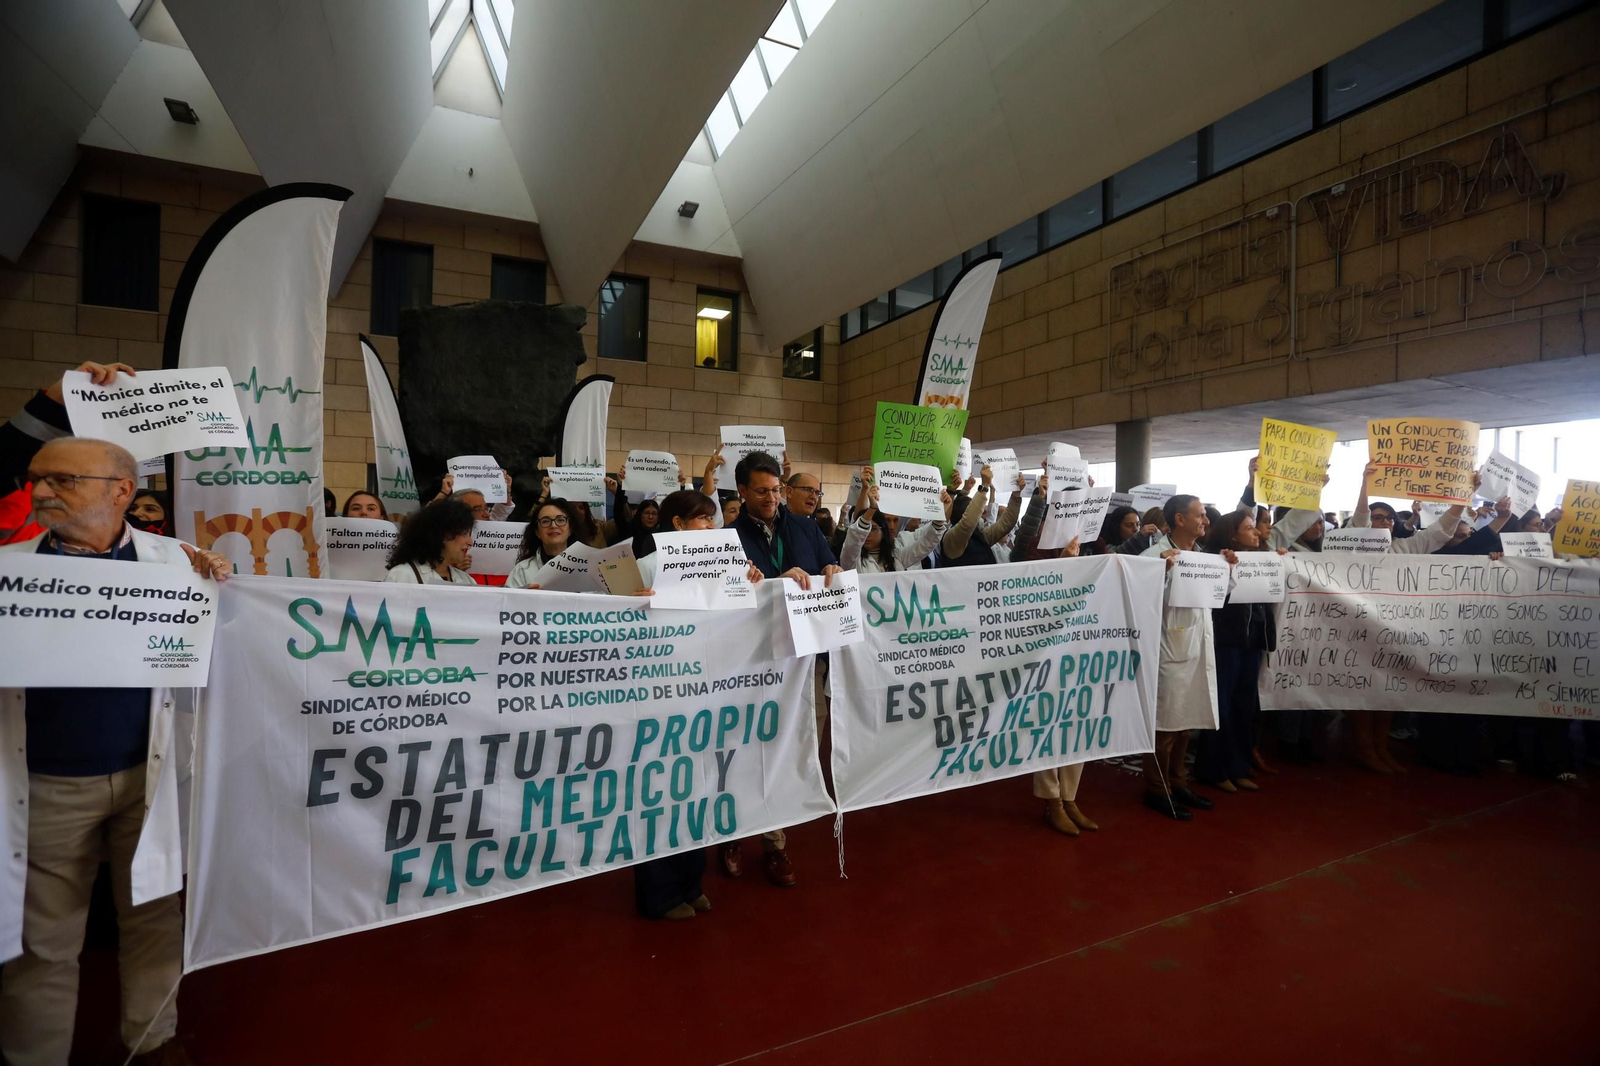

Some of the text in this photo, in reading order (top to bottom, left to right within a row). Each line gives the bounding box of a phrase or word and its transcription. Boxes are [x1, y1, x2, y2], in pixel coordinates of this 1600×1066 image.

[1111, 221, 1288, 317] Regala
[1112, 317, 1232, 379] dona
[930, 353, 969, 376] SMA
[71, 378, 224, 402] “Mónica dimite, el
[102, 395, 209, 420] médico no te
[128, 411, 194, 433] admite”
[884, 426, 903, 440] ES
[1265, 422, 1286, 442] PARA
[1372, 421, 1469, 441] UN CONDUCTOR
[883, 443, 935, 460] ATENDER
[1377, 438, 1440, 453] NO PUEDE
[1375, 452, 1430, 466] 24 HORAS
[195, 464, 312, 486] CÓRDOBA
[880, 469, 939, 484] ¡Mónica petarda,
[1260, 477, 1281, 491] PERO
[1384, 467, 1467, 485] PERO UN MÉDICO
[879, 479, 940, 495] haz tú la guardia!
[1566, 524, 1585, 535] UN
[488, 541, 496, 549] tú
[662, 545, 680, 555] “De
[682, 544, 715, 556] España
[663, 560, 697, 572] porque
[697, 557, 718, 570] aquí
[731, 556, 747, 567] hay
[1237, 570, 1252, 579] ¡Stop
[680, 570, 727, 581] porvenir”
[977, 571, 1063, 593] POR FORMACIÓN
[1194, 572, 1224, 580] protección”
[1397, 566, 1421, 592] UN
[1428, 564, 1518, 594] ESTATUTO
[1536, 566, 1585, 594] DEL
[0, 576, 210, 604] Médico quemado,
[807, 585, 858, 601] explotación,
[977, 583, 1096, 609] POR RESPONSABILIDAD
[83, 605, 211, 625] colapsado”
[803, 597, 853, 616] protección”
[866, 580, 966, 630] SMA
[979, 599, 1087, 626] POR NUESTRA SALUD
[1286, 601, 1301, 619] EN
[1304, 603, 1316, 618] LA
[1320, 602, 1348, 619] MESA
[1355, 603, 1368, 619] DE
[1430, 602, 1449, 621] LOS
[1458, 602, 1499, 620] MÉDICOS
[1507, 602, 1548, 621] SOMOS
[1558, 604, 1593, 622] SOLO
[499, 607, 648, 626] POR FORMACIÓN
[287, 595, 479, 667] SMA
[501, 624, 696, 646] POR RESPONSABILIDAD
[979, 613, 1099, 643] POR NUESTRAS FAMILIAS
[1280, 626, 1600, 649] ES COMO EN UNA COMUNIDAD DE 100 DONDE
[147, 635, 195, 651] SMA
[877, 643, 966, 663] SINDICATO MÉDICO
[980, 628, 1100, 660] POR LA DIGNIDAD DE UNA
[498, 644, 675, 666] POR NUESTRA SALUD
[1319, 647, 1339, 668] EN
[1344, 649, 1360, 668] EL
[1371, 647, 1417, 671] ÚLTIMO
[1427, 651, 1458, 676] PISO
[1474, 653, 1482, 675] Y
[1491, 653, 1557, 675] NECESITAN
[1573, 656, 1595, 678] EL
[497, 660, 703, 690] POR NUESTRAS FAMILIAS
[894, 658, 956, 675] DE CÓRDOBA
[498, 668, 784, 714] POR LA DIGNIDAD DE UNA PROFESIÓN
[886, 649, 1142, 723] ESTATUTO PROPIO
[1273, 672, 1302, 690] PERO
[1308, 672, 1322, 687] LO
[1327, 671, 1372, 690] DECIDEN
[1384, 674, 1408, 692] LOS
[1415, 677, 1456, 693] OTROS
[1515, 679, 1540, 699] ASÍ
[1546, 681, 1600, 706] SIEMPRE
[300, 688, 472, 716] SINDICATO MÉDICO
[332, 712, 448, 735] DE CÓRDOBA
[933, 682, 1116, 749] DEL MÉDICO Y
[306, 700, 780, 808] ESTATUTO PROPIO
[929, 716, 1112, 780] FACULTATIVO
[384, 748, 736, 853] DEL MÉDICO Y
[385, 792, 738, 905] FACULTATIVO
